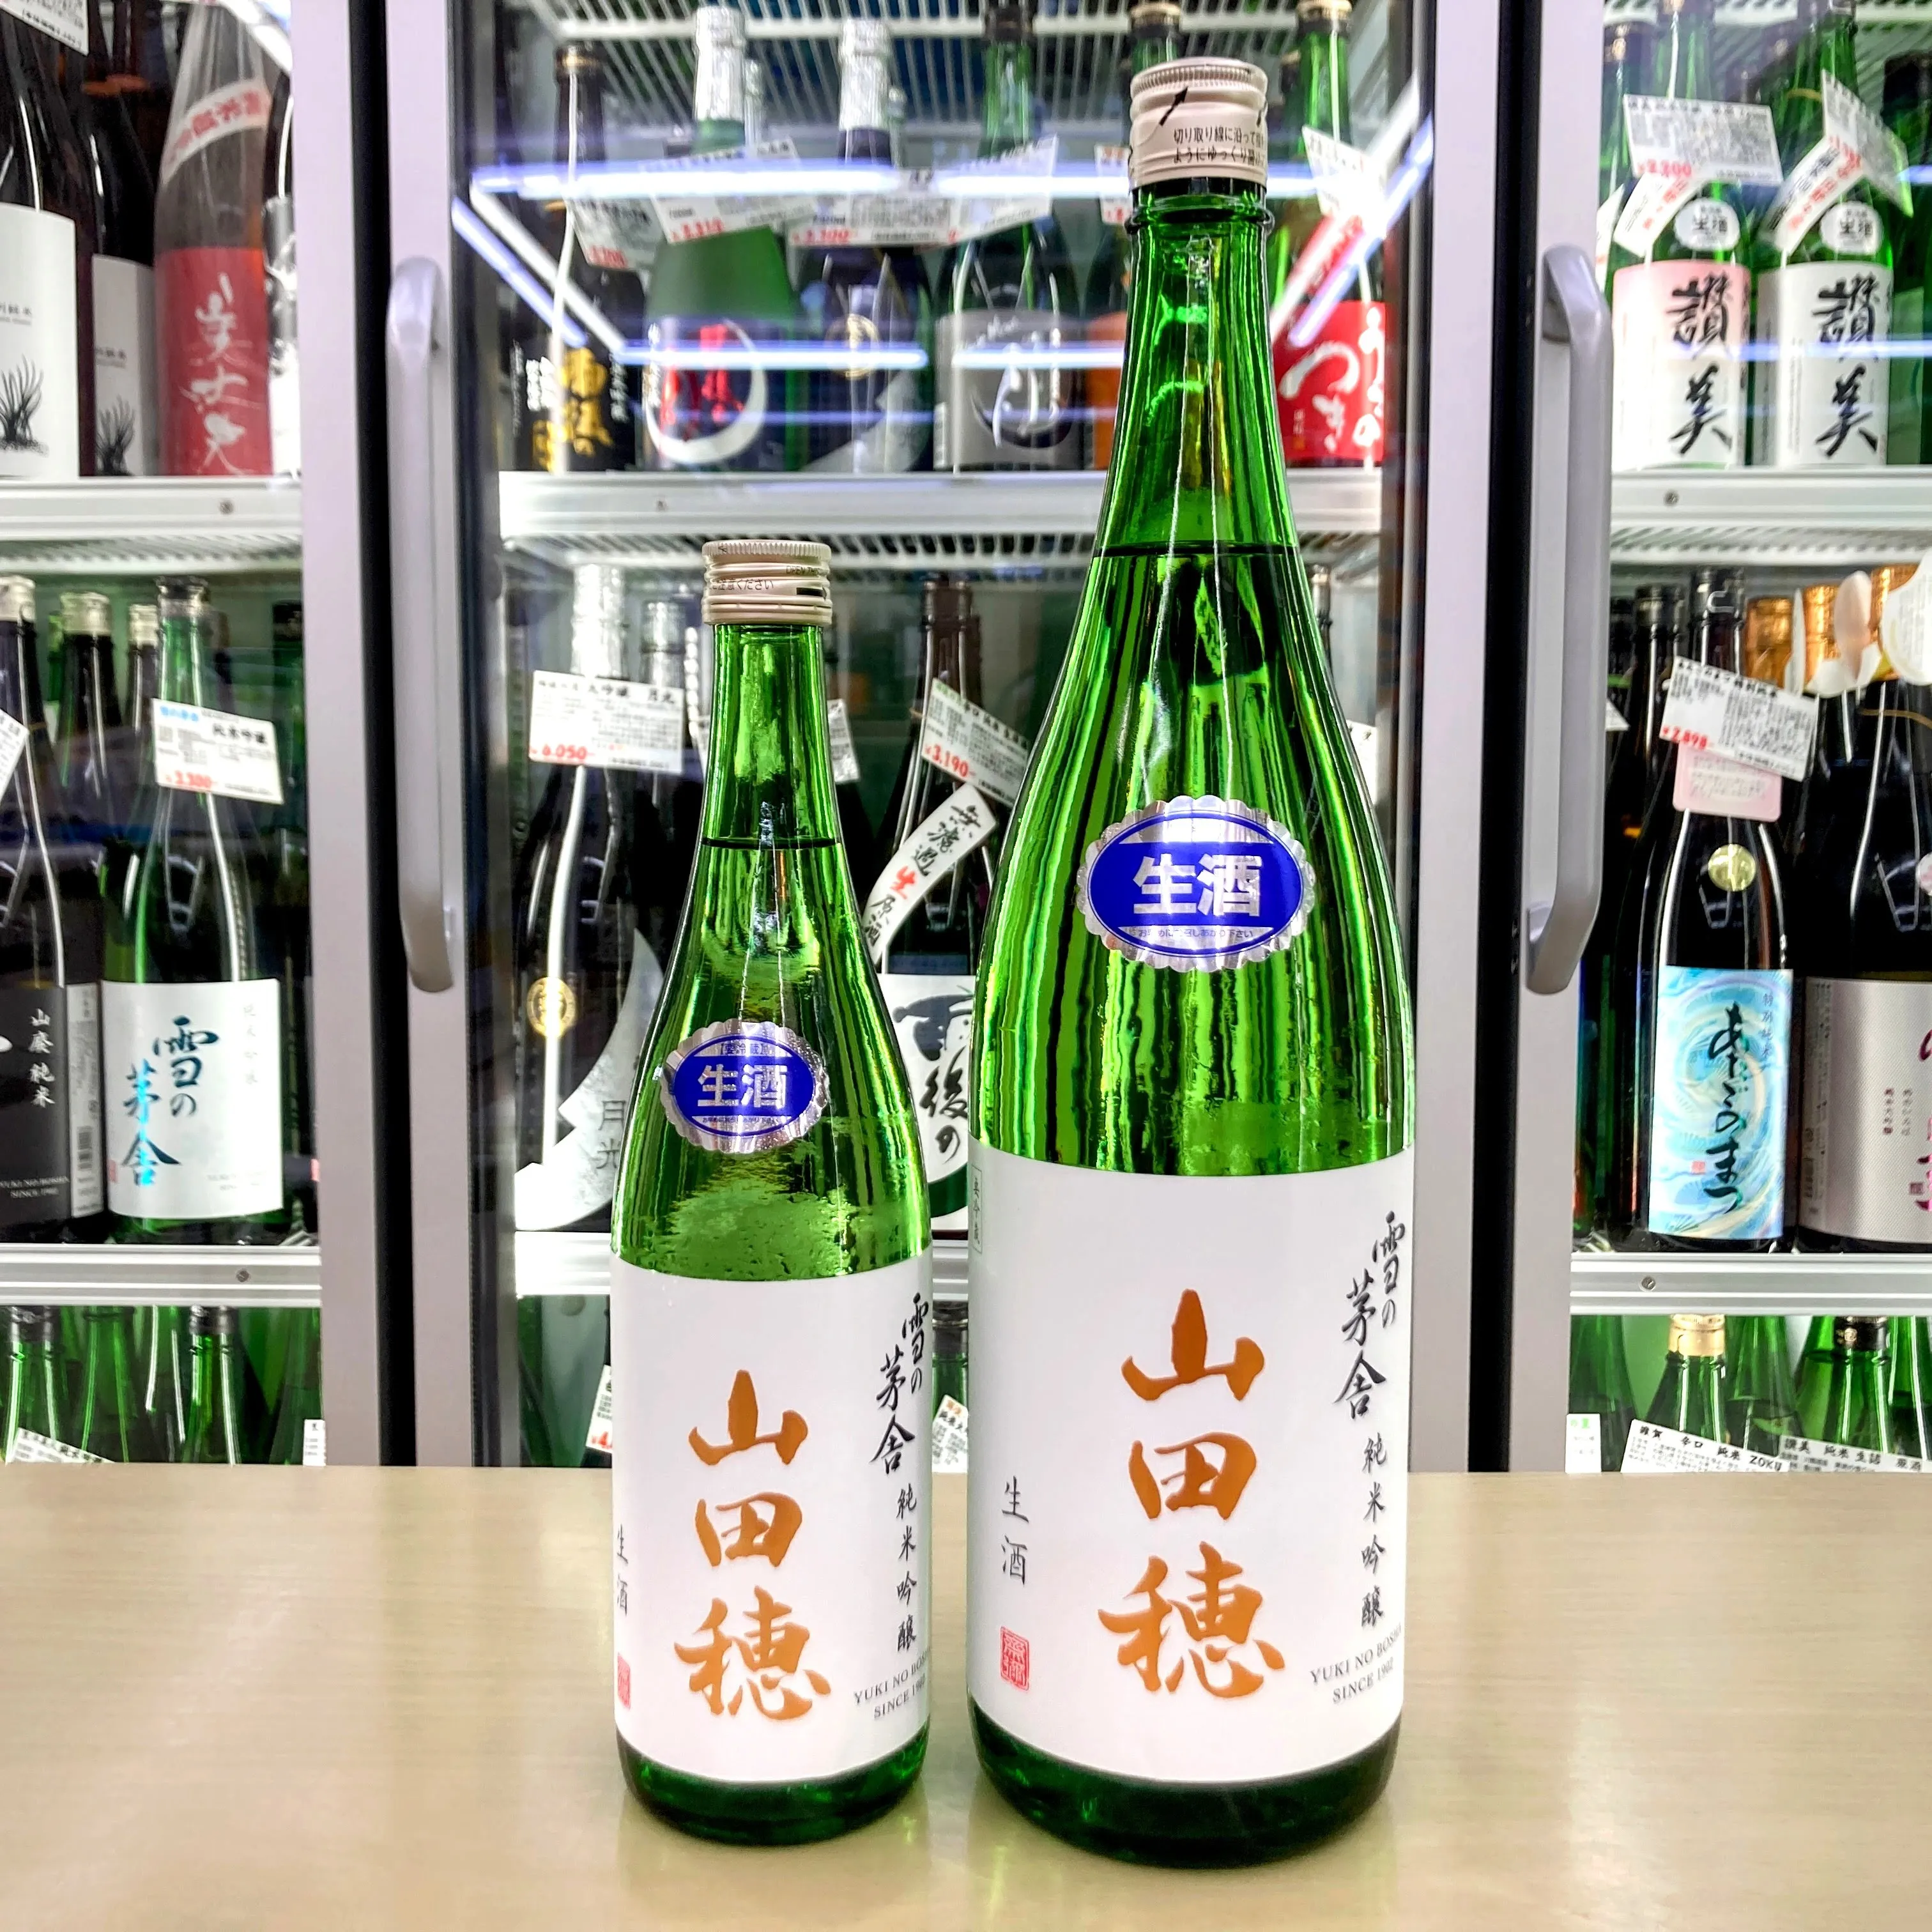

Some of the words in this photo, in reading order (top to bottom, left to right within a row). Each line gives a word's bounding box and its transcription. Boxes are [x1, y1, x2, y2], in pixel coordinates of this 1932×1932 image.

[1133, 853, 1263, 917] 生酒
[1761, 992, 1774, 1058] 特別純米
[697, 1063, 788, 1110] 生酒
[1703, 1000, 1750, 1215] あたごのまつ
[1000, 1475, 1029, 1586] 生酒
[1098, 1288, 1286, 1698] 山田穂
[1361, 1432, 1388, 1629] 純米吟醸
[617, 1522, 629, 1616] 生酒
[673, 1368, 832, 1721] 山田穂
[896, 1483, 917, 1653] 純米吟醸
[854, 1681, 888, 1704] YUKI
[893, 1669, 908, 1689] NO
[874, 1689, 909, 1719] SINCE
[1310, 1659, 1349, 1684] YUKI
[1354, 1649, 1374, 1670] NO
[1333, 1673, 1374, 1703] SINCE
